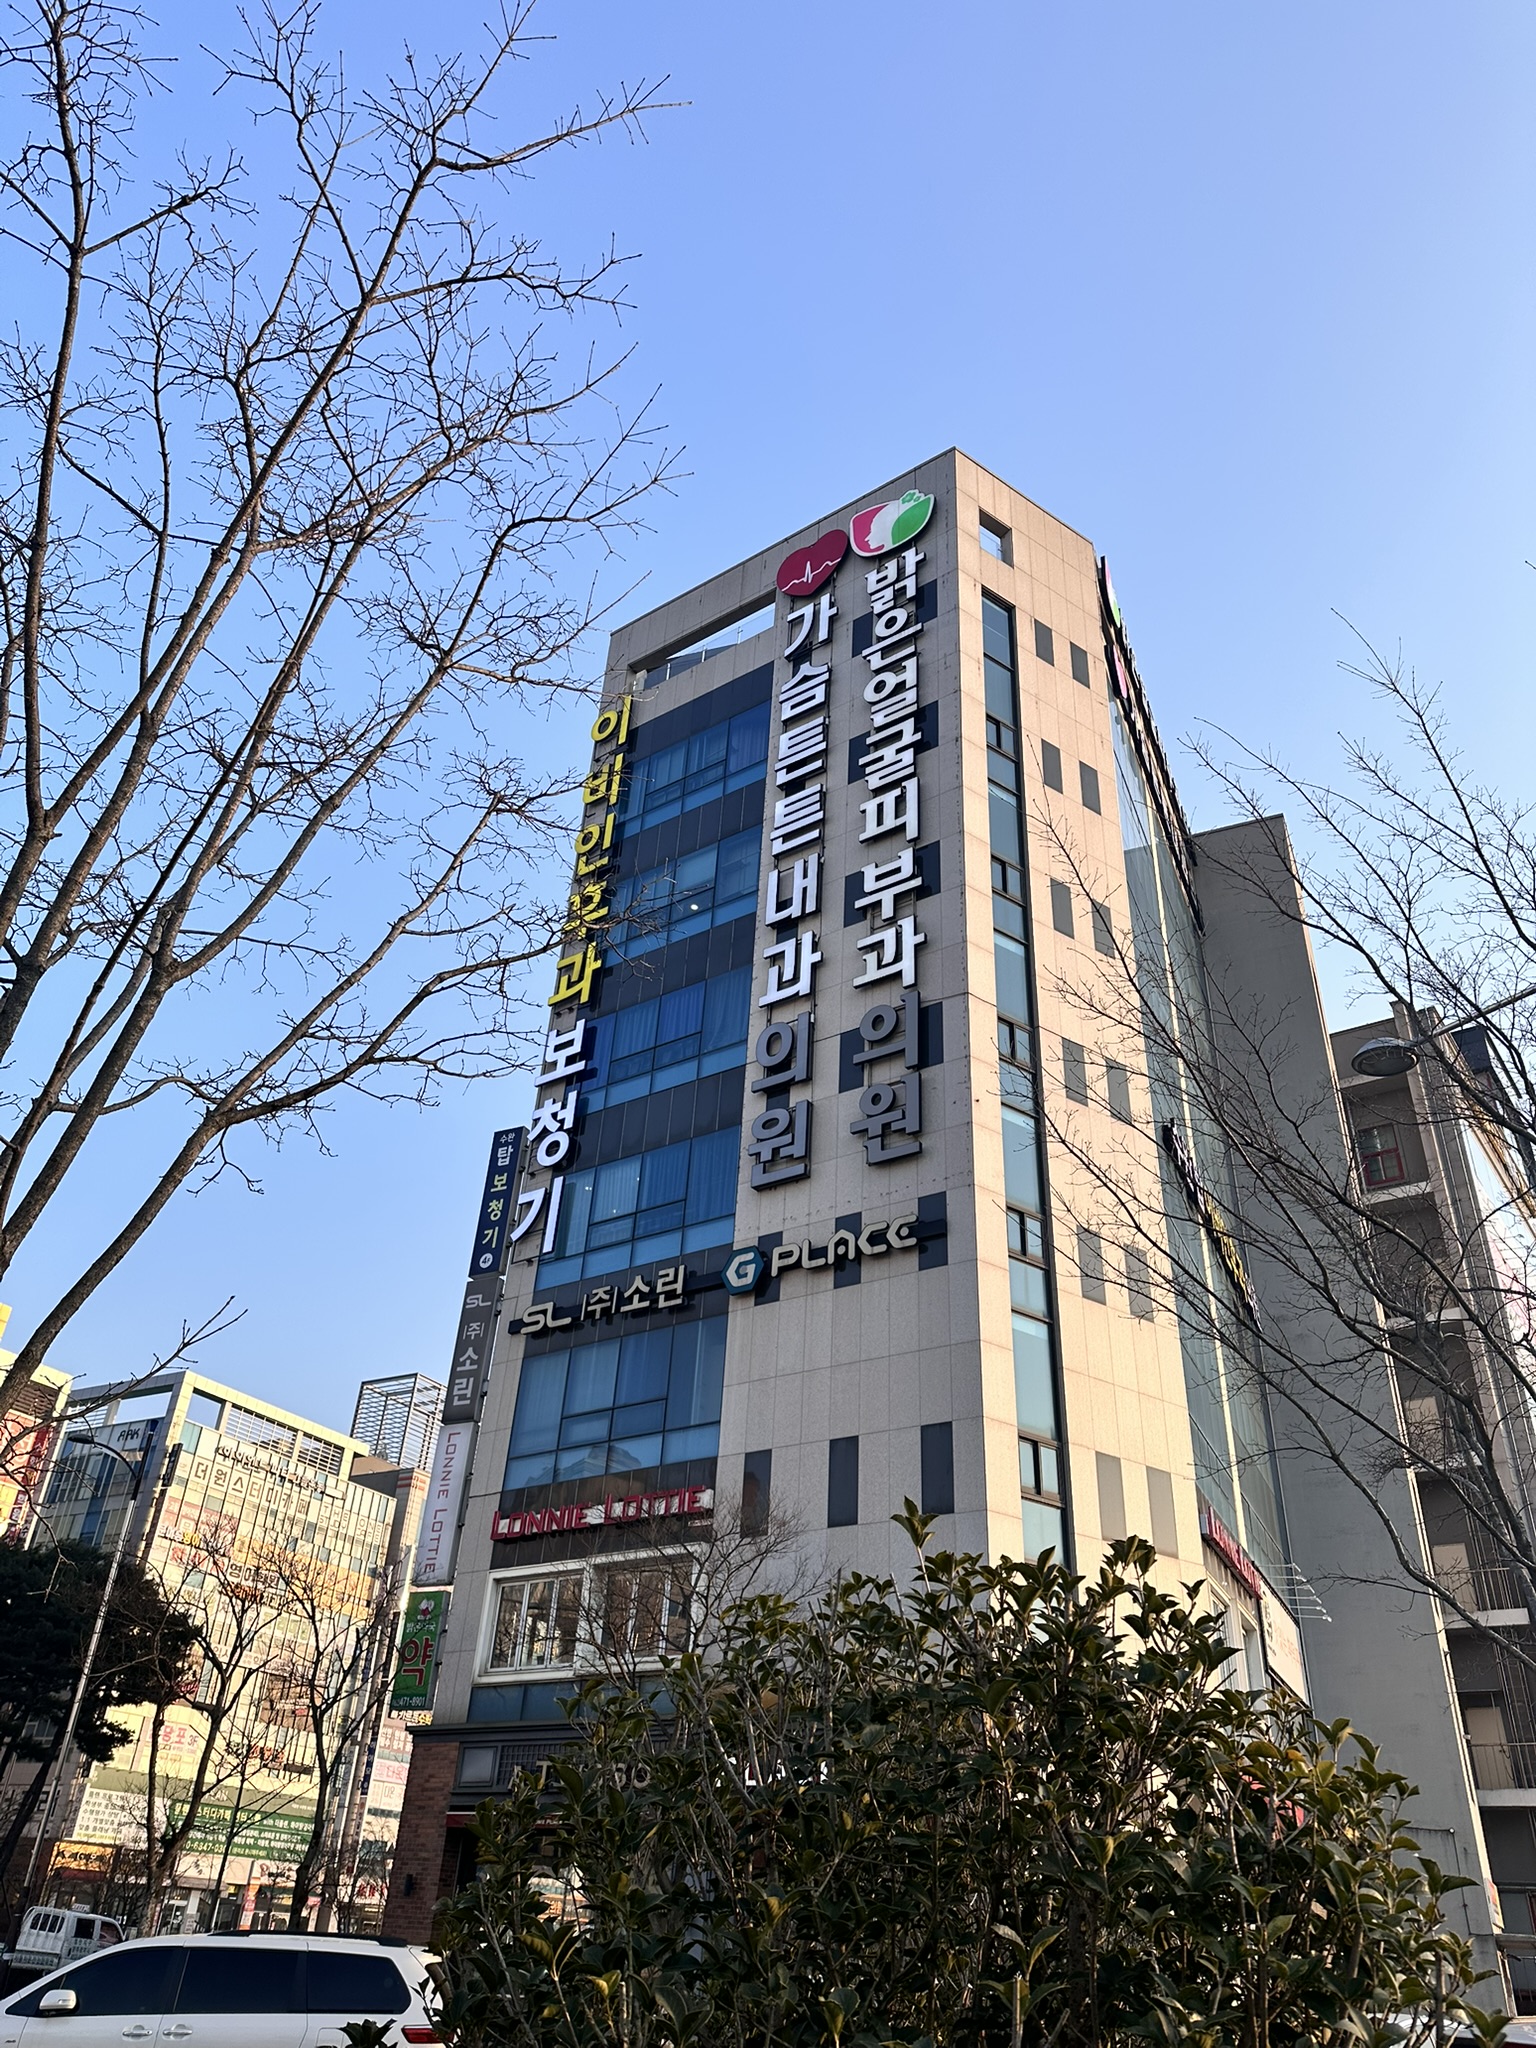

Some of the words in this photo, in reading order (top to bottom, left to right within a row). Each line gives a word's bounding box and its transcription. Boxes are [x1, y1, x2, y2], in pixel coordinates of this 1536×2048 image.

[509, 1018, 587, 1254] 보청기
[520, 1301, 572, 1335] SL
[437, 1431, 462, 1500] LONNIE
[423, 1508, 448, 1574] LOTTIE
[490, 1501, 593, 1542] LONNIE
[603, 1485, 707, 1526] LOTTIE
[401, 1635, 435, 1687] 약
